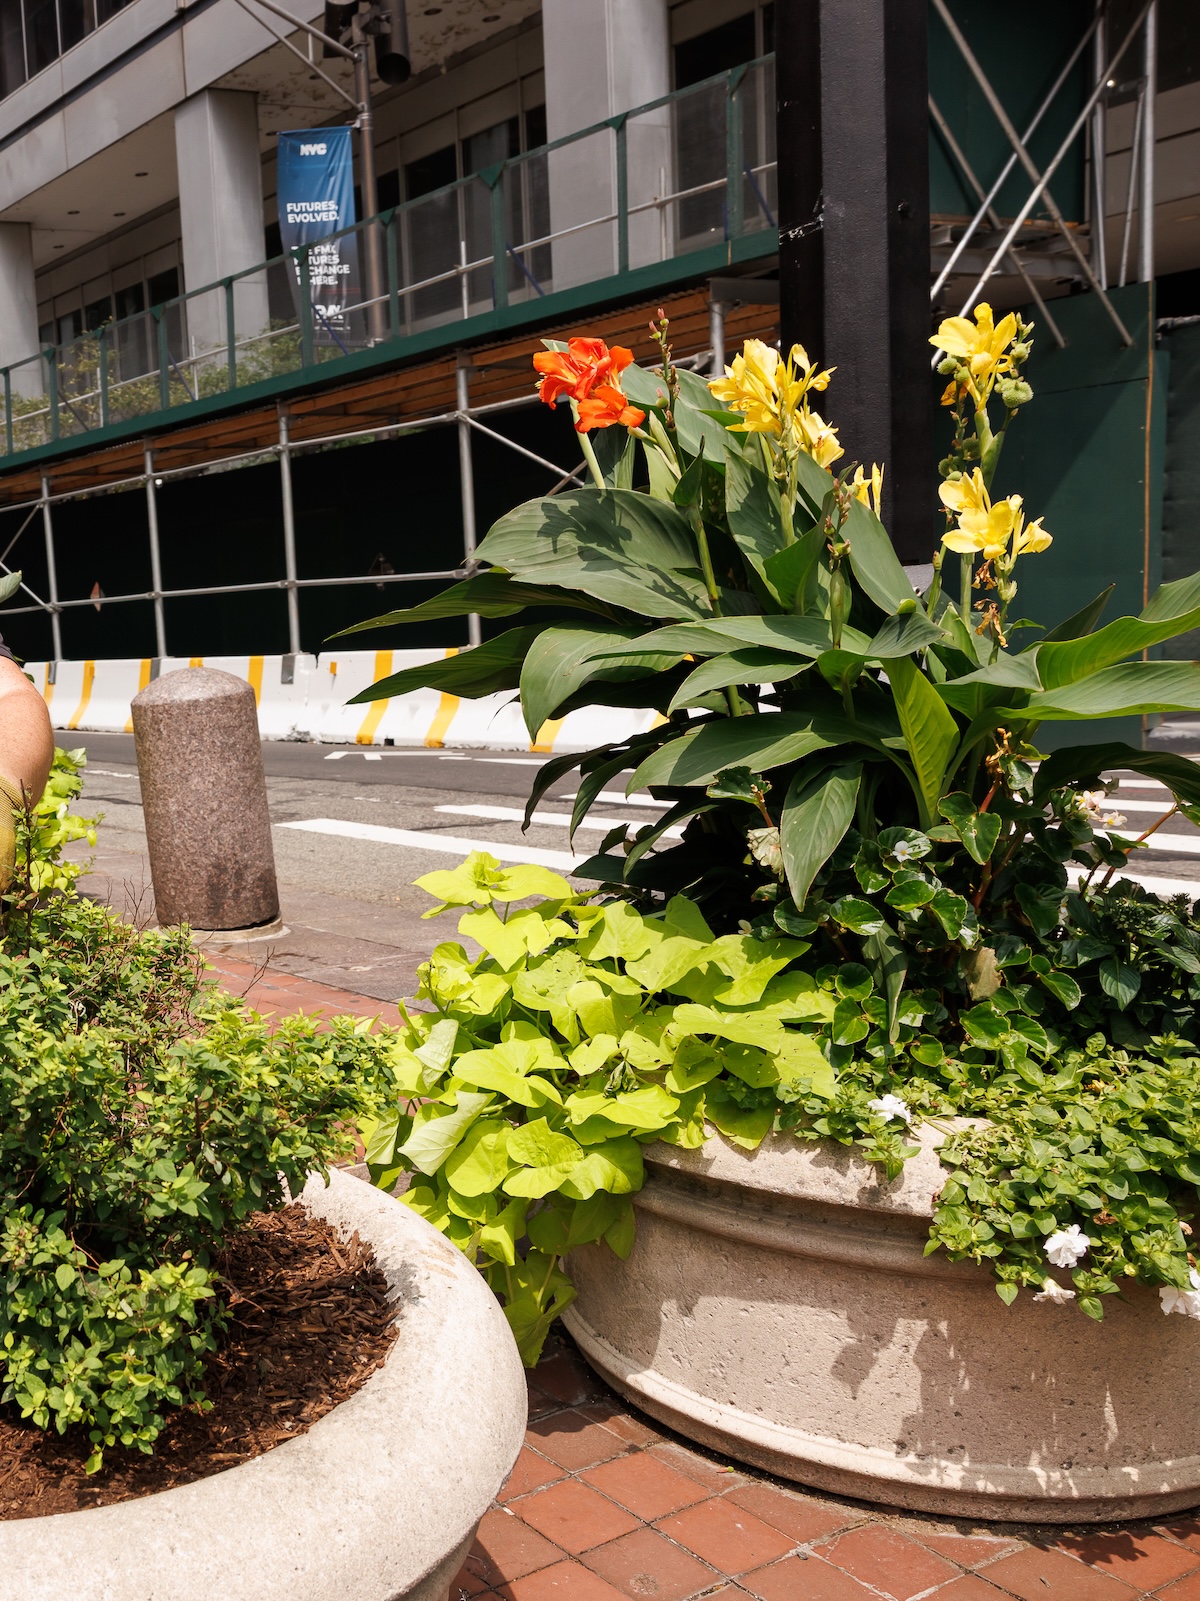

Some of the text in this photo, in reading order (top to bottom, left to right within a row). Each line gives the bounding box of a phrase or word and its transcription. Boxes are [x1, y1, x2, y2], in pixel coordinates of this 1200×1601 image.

[300, 143, 327, 156] NYC
[286, 200, 339, 213] FUTURES,
[287, 211, 340, 223] EVOLVED.
[293, 254, 340, 266] FTURES
[295, 264, 351, 276] ECHANGE
